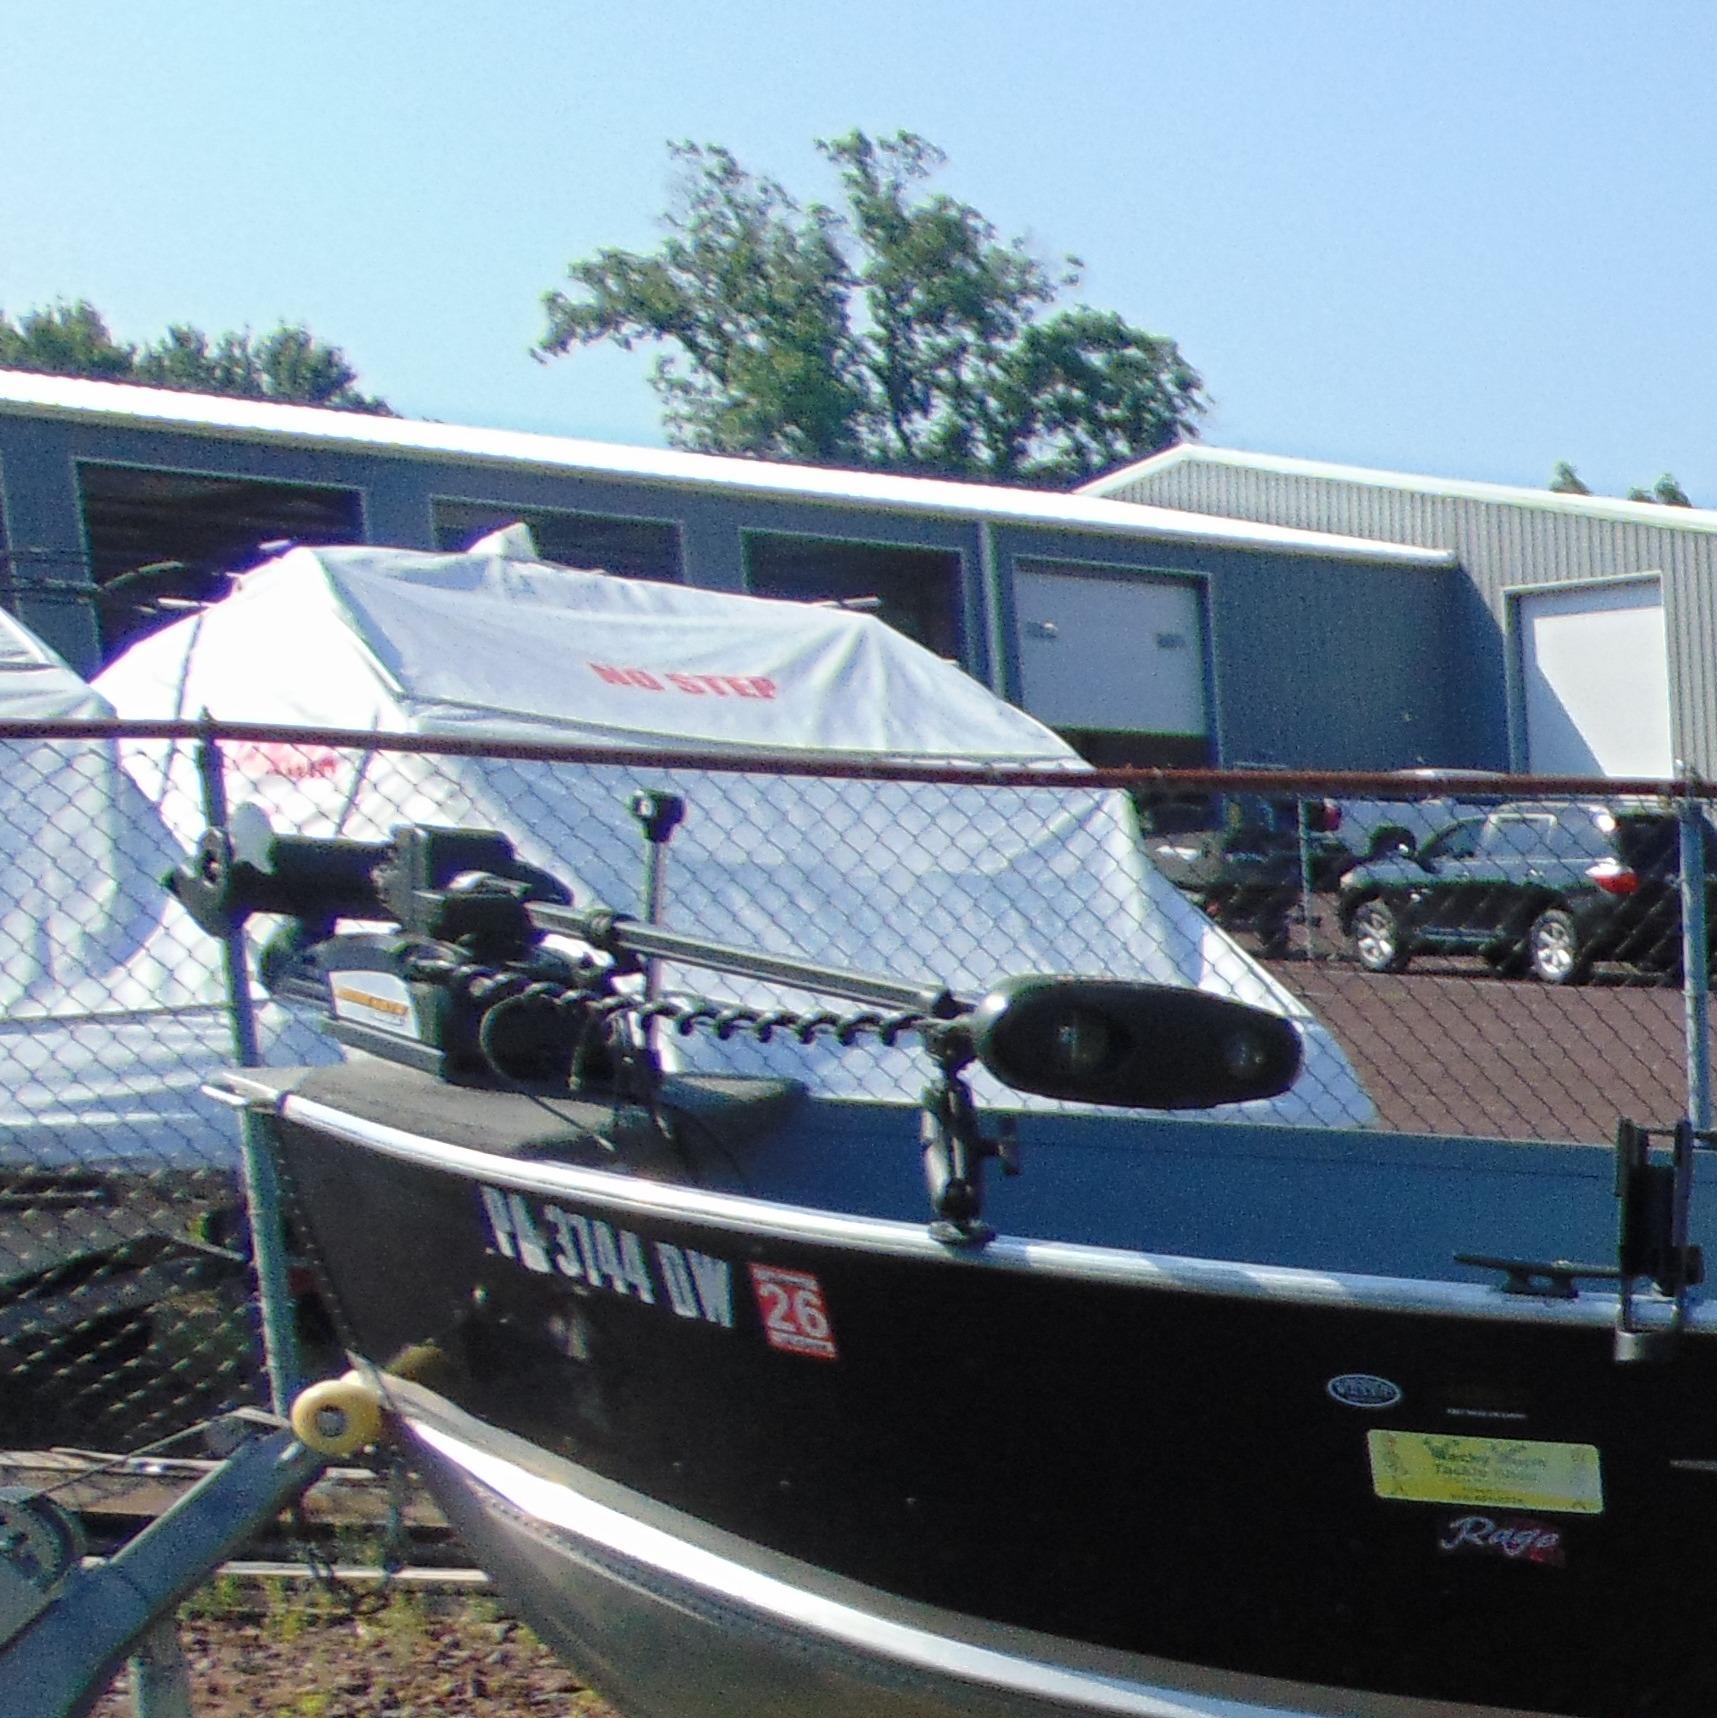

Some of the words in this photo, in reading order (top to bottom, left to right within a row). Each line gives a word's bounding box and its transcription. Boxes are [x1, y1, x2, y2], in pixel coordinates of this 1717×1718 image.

[589, 661, 665, 691] NO
[664, 672, 776, 699] STEP
[543, 1203, 657, 1305] 3744
[654, 1240, 735, 1329] DW
[758, 1282, 832, 1340] 26
[1439, 1515, 1560, 1557] Rage
